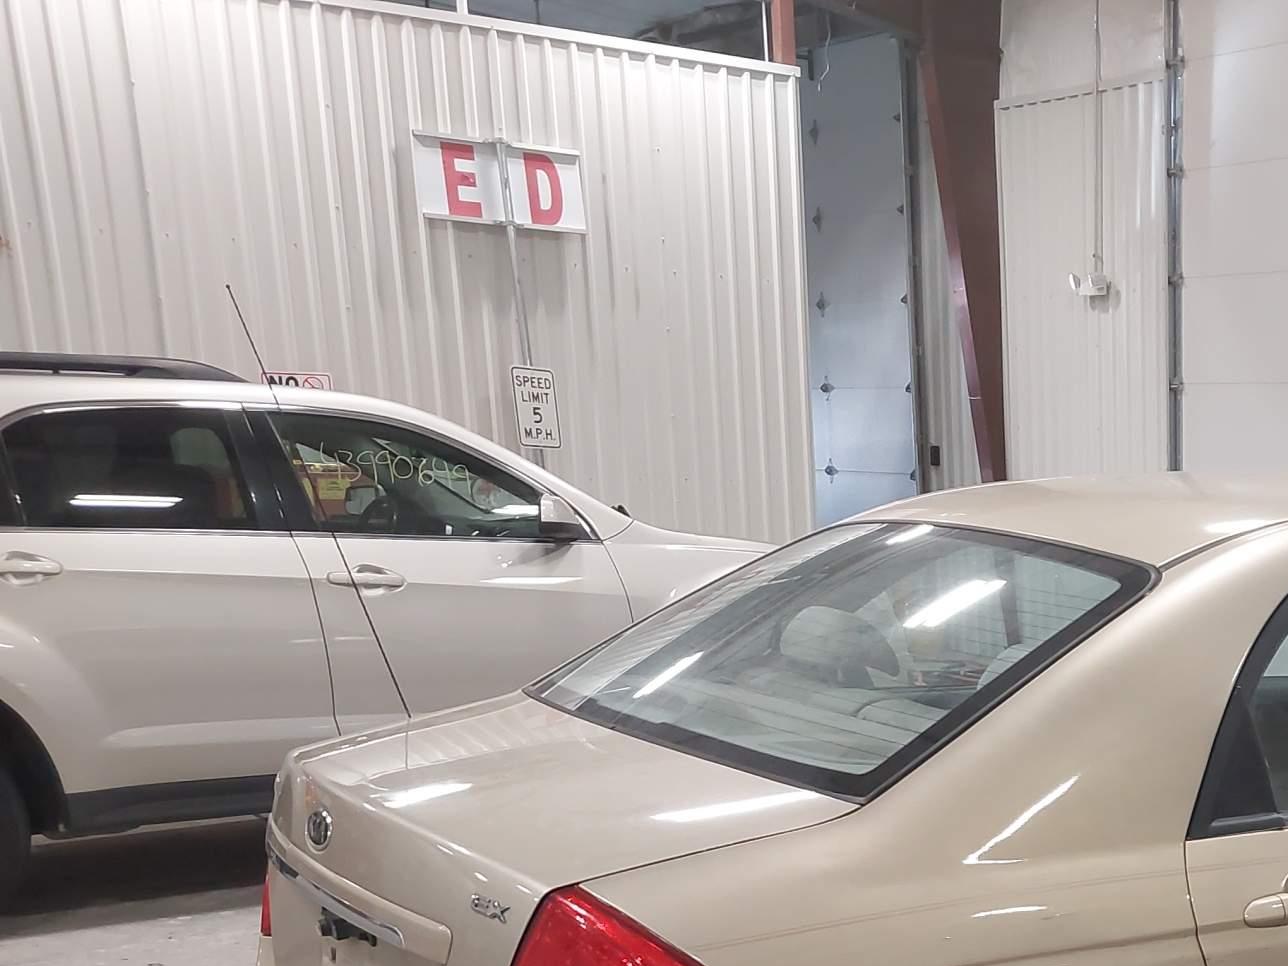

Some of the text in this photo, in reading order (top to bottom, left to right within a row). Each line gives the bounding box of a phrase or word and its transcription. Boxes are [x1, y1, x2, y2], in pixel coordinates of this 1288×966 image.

[440, 142, 564, 225] E D
[515, 375, 551, 390] SPEED
[521, 391, 549, 404] LIMIT
[533, 407, 543, 424] 5
[524, 428, 556, 441] M.P.H.
